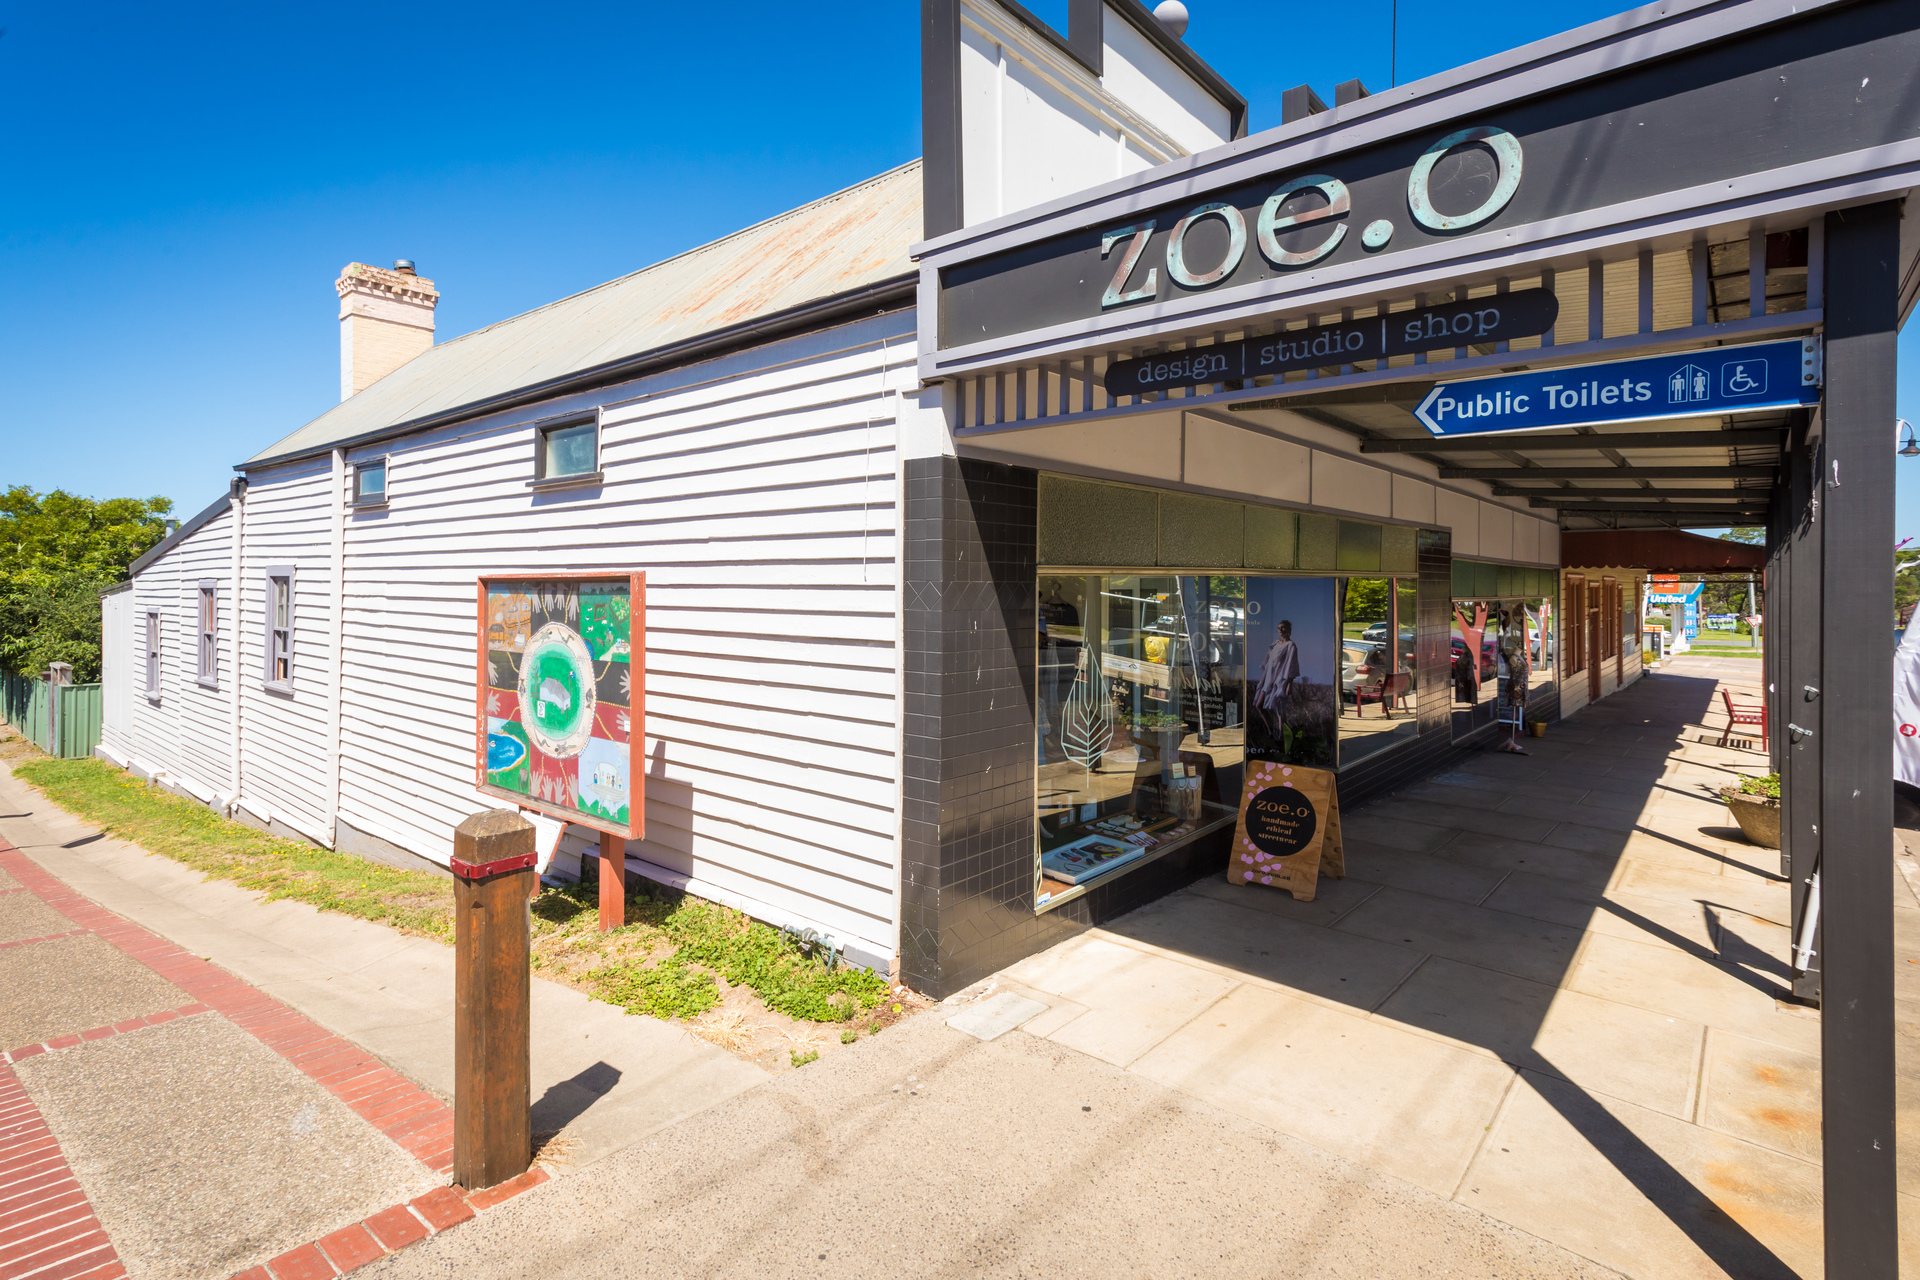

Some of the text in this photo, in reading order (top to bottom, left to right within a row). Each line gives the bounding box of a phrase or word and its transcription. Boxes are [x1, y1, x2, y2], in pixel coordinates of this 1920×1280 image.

[1100, 125, 1524, 307] zoe.o
[1137, 306, 1501, 384] design studio shop
[1436, 377, 1652, 421] Public Toilets
[1650, 595, 1687, 603] United
[1256, 800, 1308, 818] zoe.o
[1261, 815, 1300, 828] handmade
[1265, 823, 1292, 835] ethical
[1258, 833, 1298, 845] streetwear
